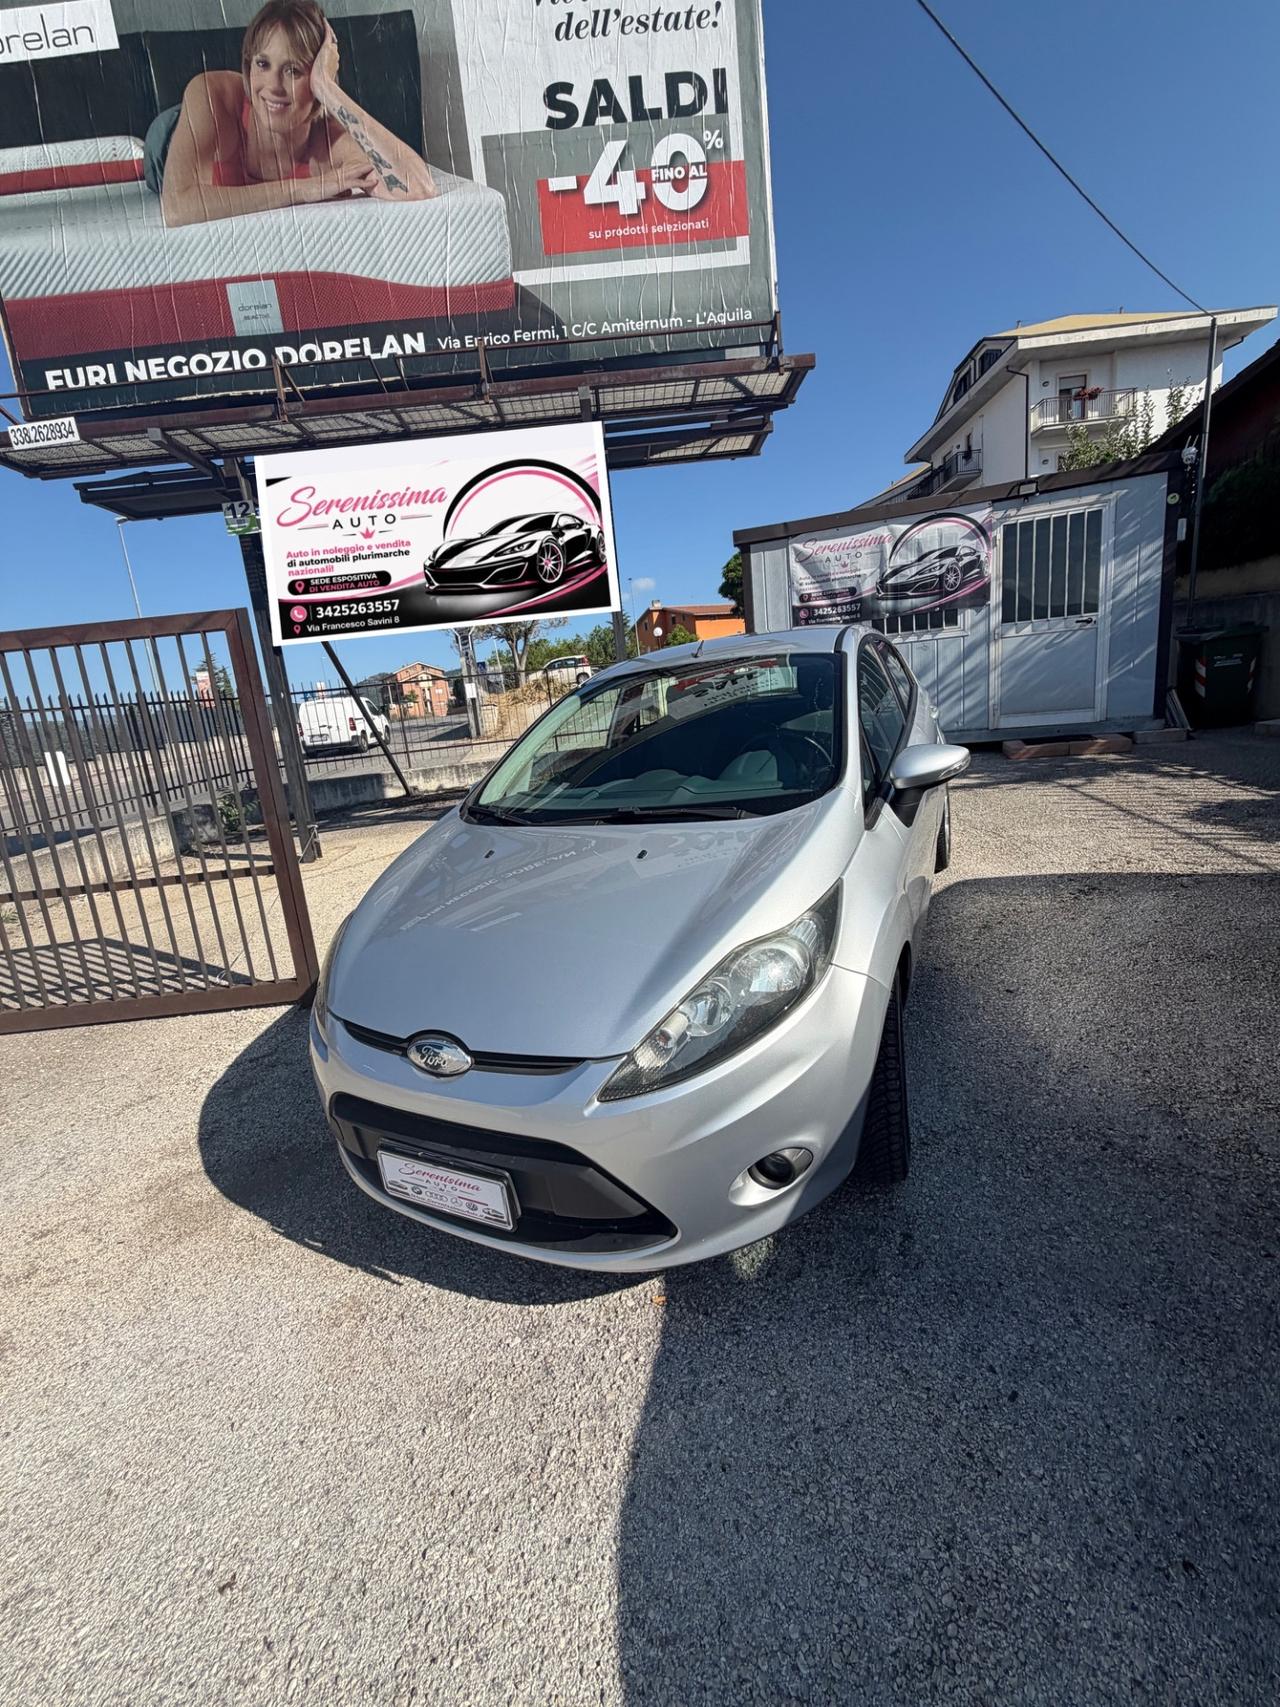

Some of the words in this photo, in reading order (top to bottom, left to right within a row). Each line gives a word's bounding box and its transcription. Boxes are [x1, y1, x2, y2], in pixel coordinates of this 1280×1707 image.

[555, 1, 722, 41] dell'estate!
[0, 13, 94, 54] relan
[543, 67, 728, 130] SALDI
[651, 166, 685, 181] FINO
[689, 164, 708, 178] AL
[588, 230, 602, 239] su
[604, 223, 649, 240] prodotti
[651, 217, 709, 234] selezionati
[437, 336, 461, 350] Via
[514, 325, 560, 343] Fermi,
[562, 325, 568, 338] 1
[571, 321, 597, 338] C/C
[600, 313, 683, 335] Amiternum
[695, 308, 753, 326] L'Aquila
[45, 363, 117, 391] FURI
[124, 350, 267, 382] NEGOZIO
[275, 332, 426, 366] DORELAN
[10, 420, 75, 446] 338.2628934
[276, 486, 448, 528] Serenissima
[332, 513, 397, 530] AUTO
[286, 550, 309, 559] Auto
[311, 547, 321, 556] in
[323, 543, 365, 556] noleggio
[375, 539, 411, 550] vendita
[287, 557, 297, 568] di
[299, 553, 350, 566] automobili
[352, 549, 410, 563] plurimarche
[795, 534, 893, 563] Serenissima
[825, 551, 863, 563] AUTO
[309, 585, 319, 593] DI
[320, 582, 356, 591] VENDITA
[357, 580, 380, 588] AUTO
[310, 577, 330, 586] SEDE
[332, 573, 378, 583] ESPOSITIVA
[316, 599, 400, 619] 3425263557
[306, 623, 320, 633] Via
[322, 620, 366, 631] Francesco
[367, 617, 393, 627] Savini
[394, 616, 400, 624] 8
